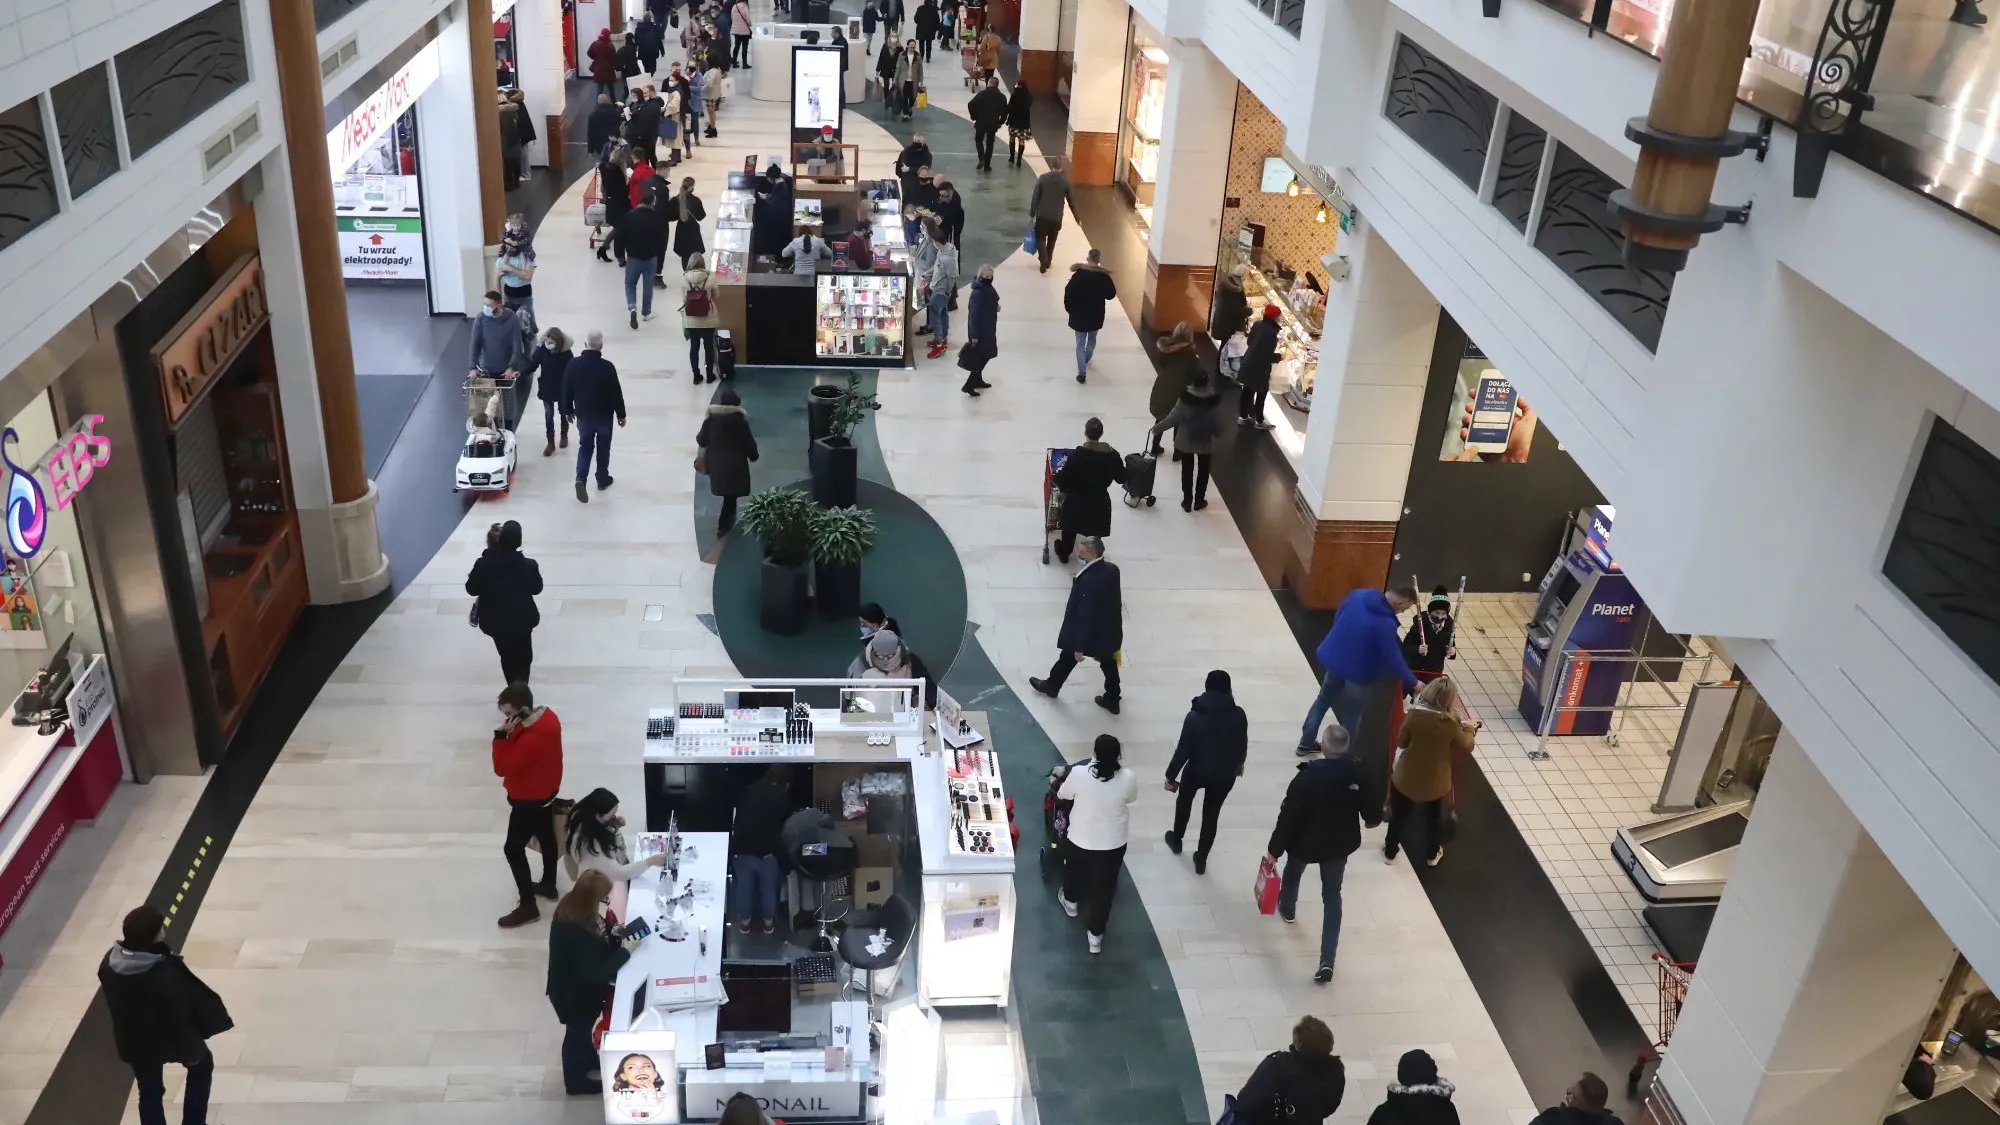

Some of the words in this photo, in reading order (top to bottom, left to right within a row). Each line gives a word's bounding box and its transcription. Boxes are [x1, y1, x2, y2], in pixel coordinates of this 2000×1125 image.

[358, 246, 368, 254] Tu
[370, 246, 397, 254] wrzuć
[344, 256, 413, 266] elektroodpady!
[48, 414, 111, 511] EBS
[1594, 518, 1610, 541] Plane
[1592, 603, 1635, 615] Planet
[1568, 668, 1584, 706] ankomat
[25, 860, 41, 885] best
[40, 823, 65, 862] services
[716, 1097, 830, 1111] NONAIL
